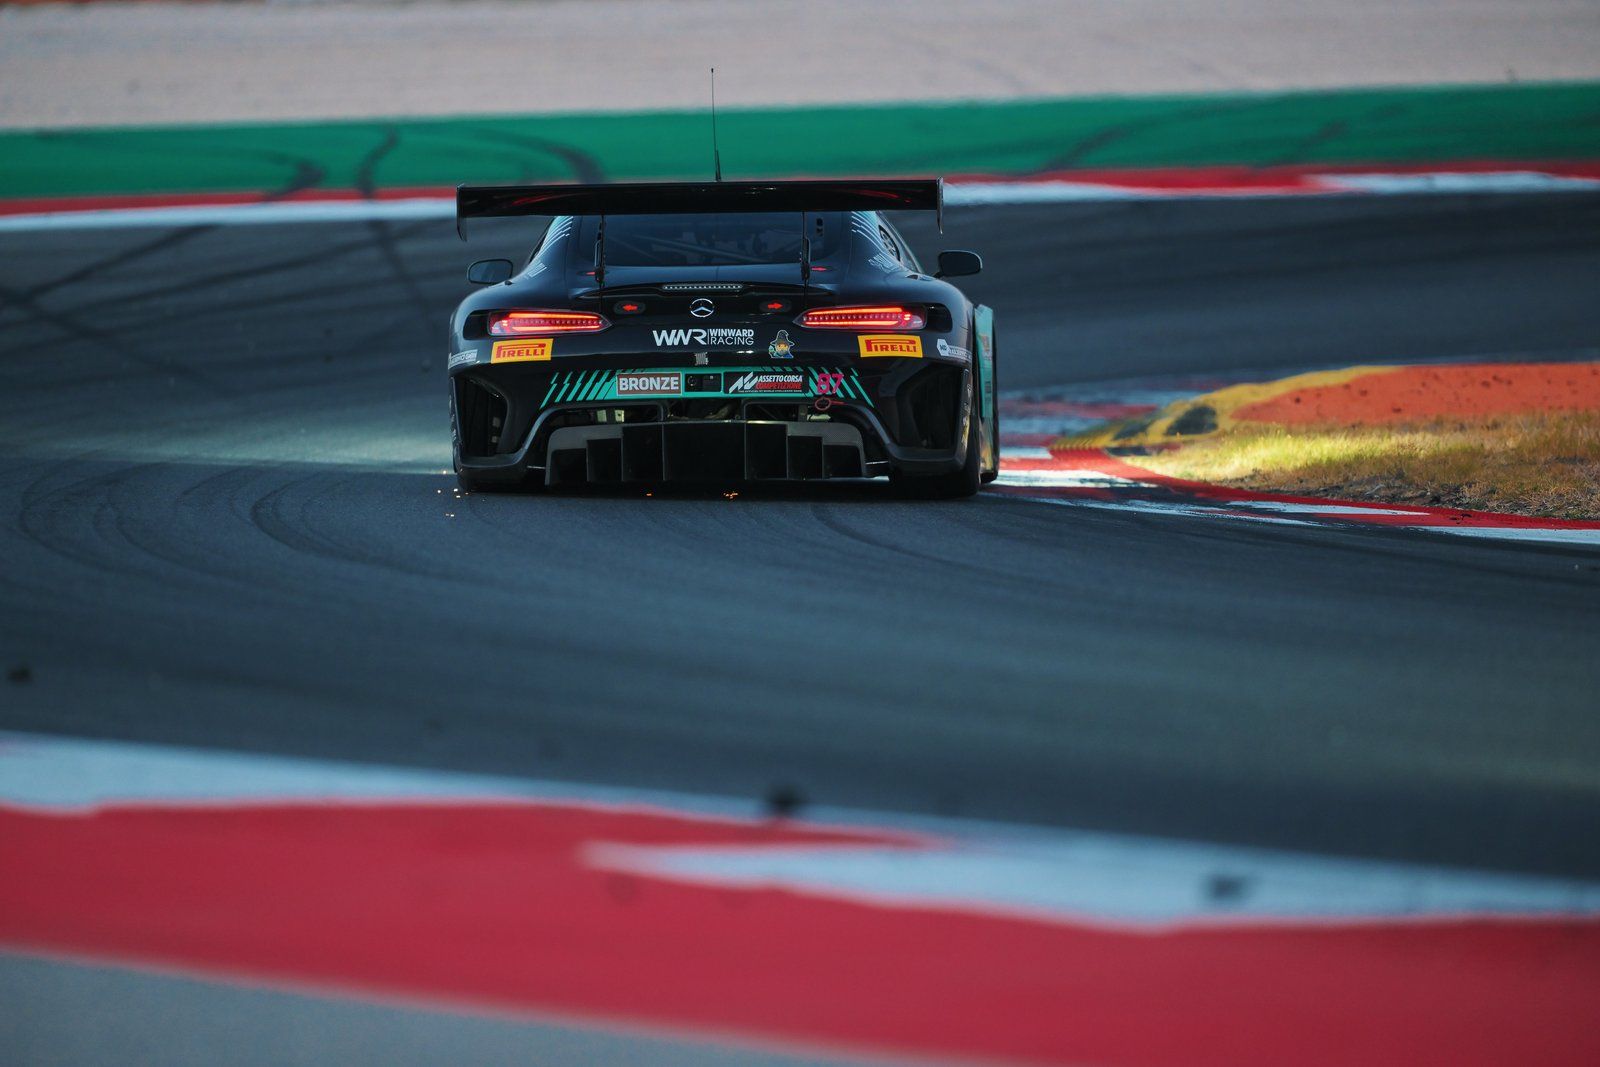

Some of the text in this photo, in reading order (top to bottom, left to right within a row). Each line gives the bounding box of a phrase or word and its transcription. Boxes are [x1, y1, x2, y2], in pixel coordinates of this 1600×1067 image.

[709, 328, 755, 337] WINWARD
[710, 336, 755, 345] RACING
[865, 339, 917, 352] PIRELLI
[496, 343, 546, 358] PIRELLI
[619, 376, 680, 391] BRONZE
[757, 374, 803, 383] ASSETTO CORSA
[817, 373, 845, 394] 87
[755, 381, 802, 390] COMPETIZIONE
